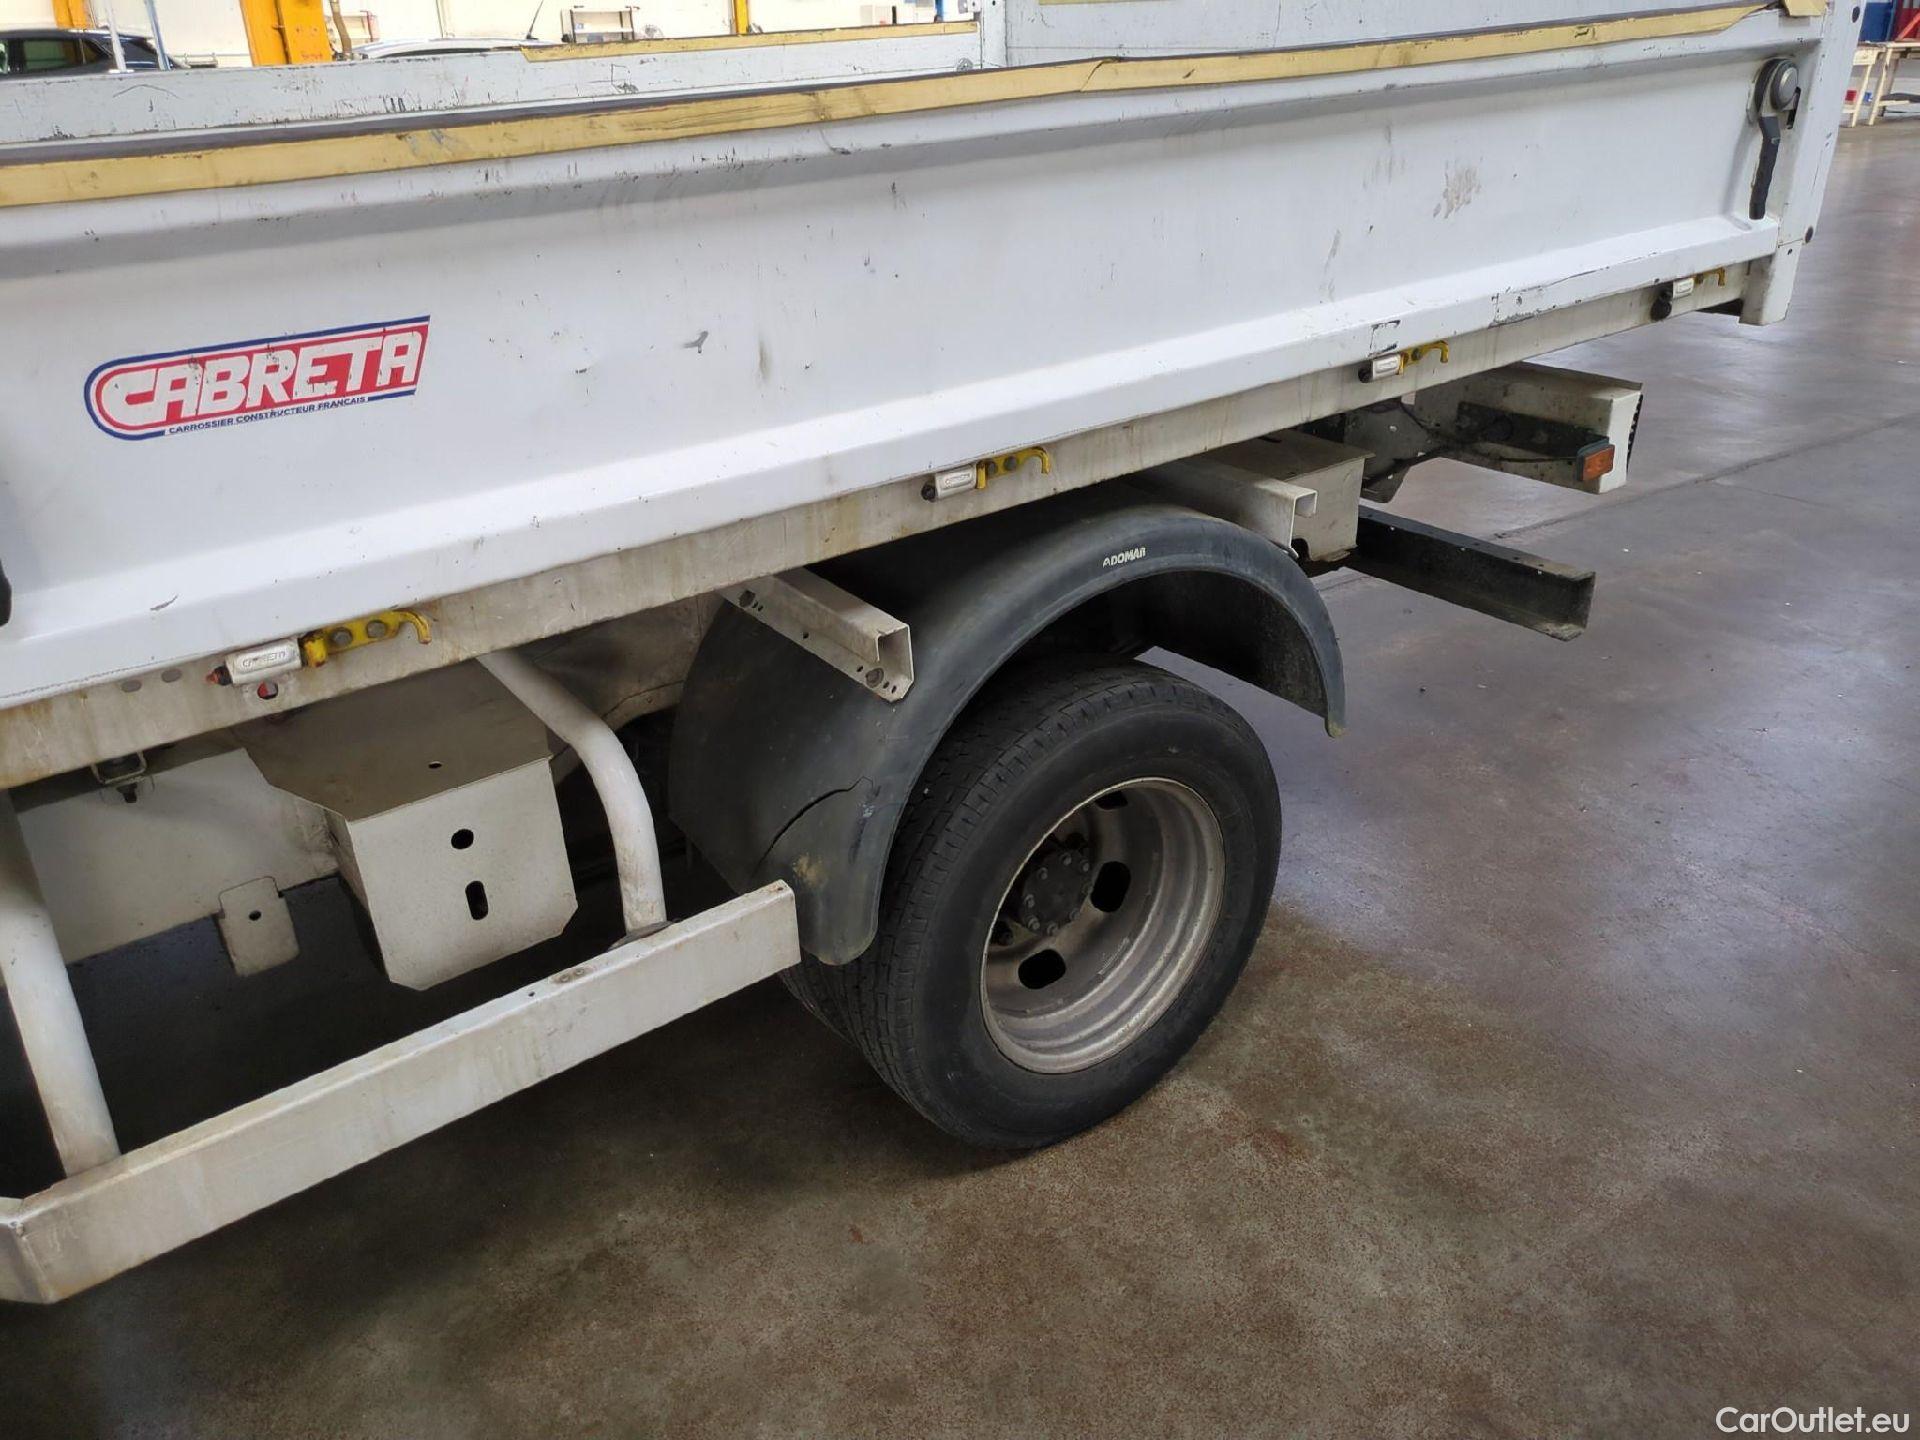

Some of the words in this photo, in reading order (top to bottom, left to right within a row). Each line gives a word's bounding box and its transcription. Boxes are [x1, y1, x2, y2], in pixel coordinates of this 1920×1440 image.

[101, 330, 423, 425] CABRETA
[168, 418, 234, 434] CARROSSIER
[235, 404, 316, 424] CONSTRUCTEUR
